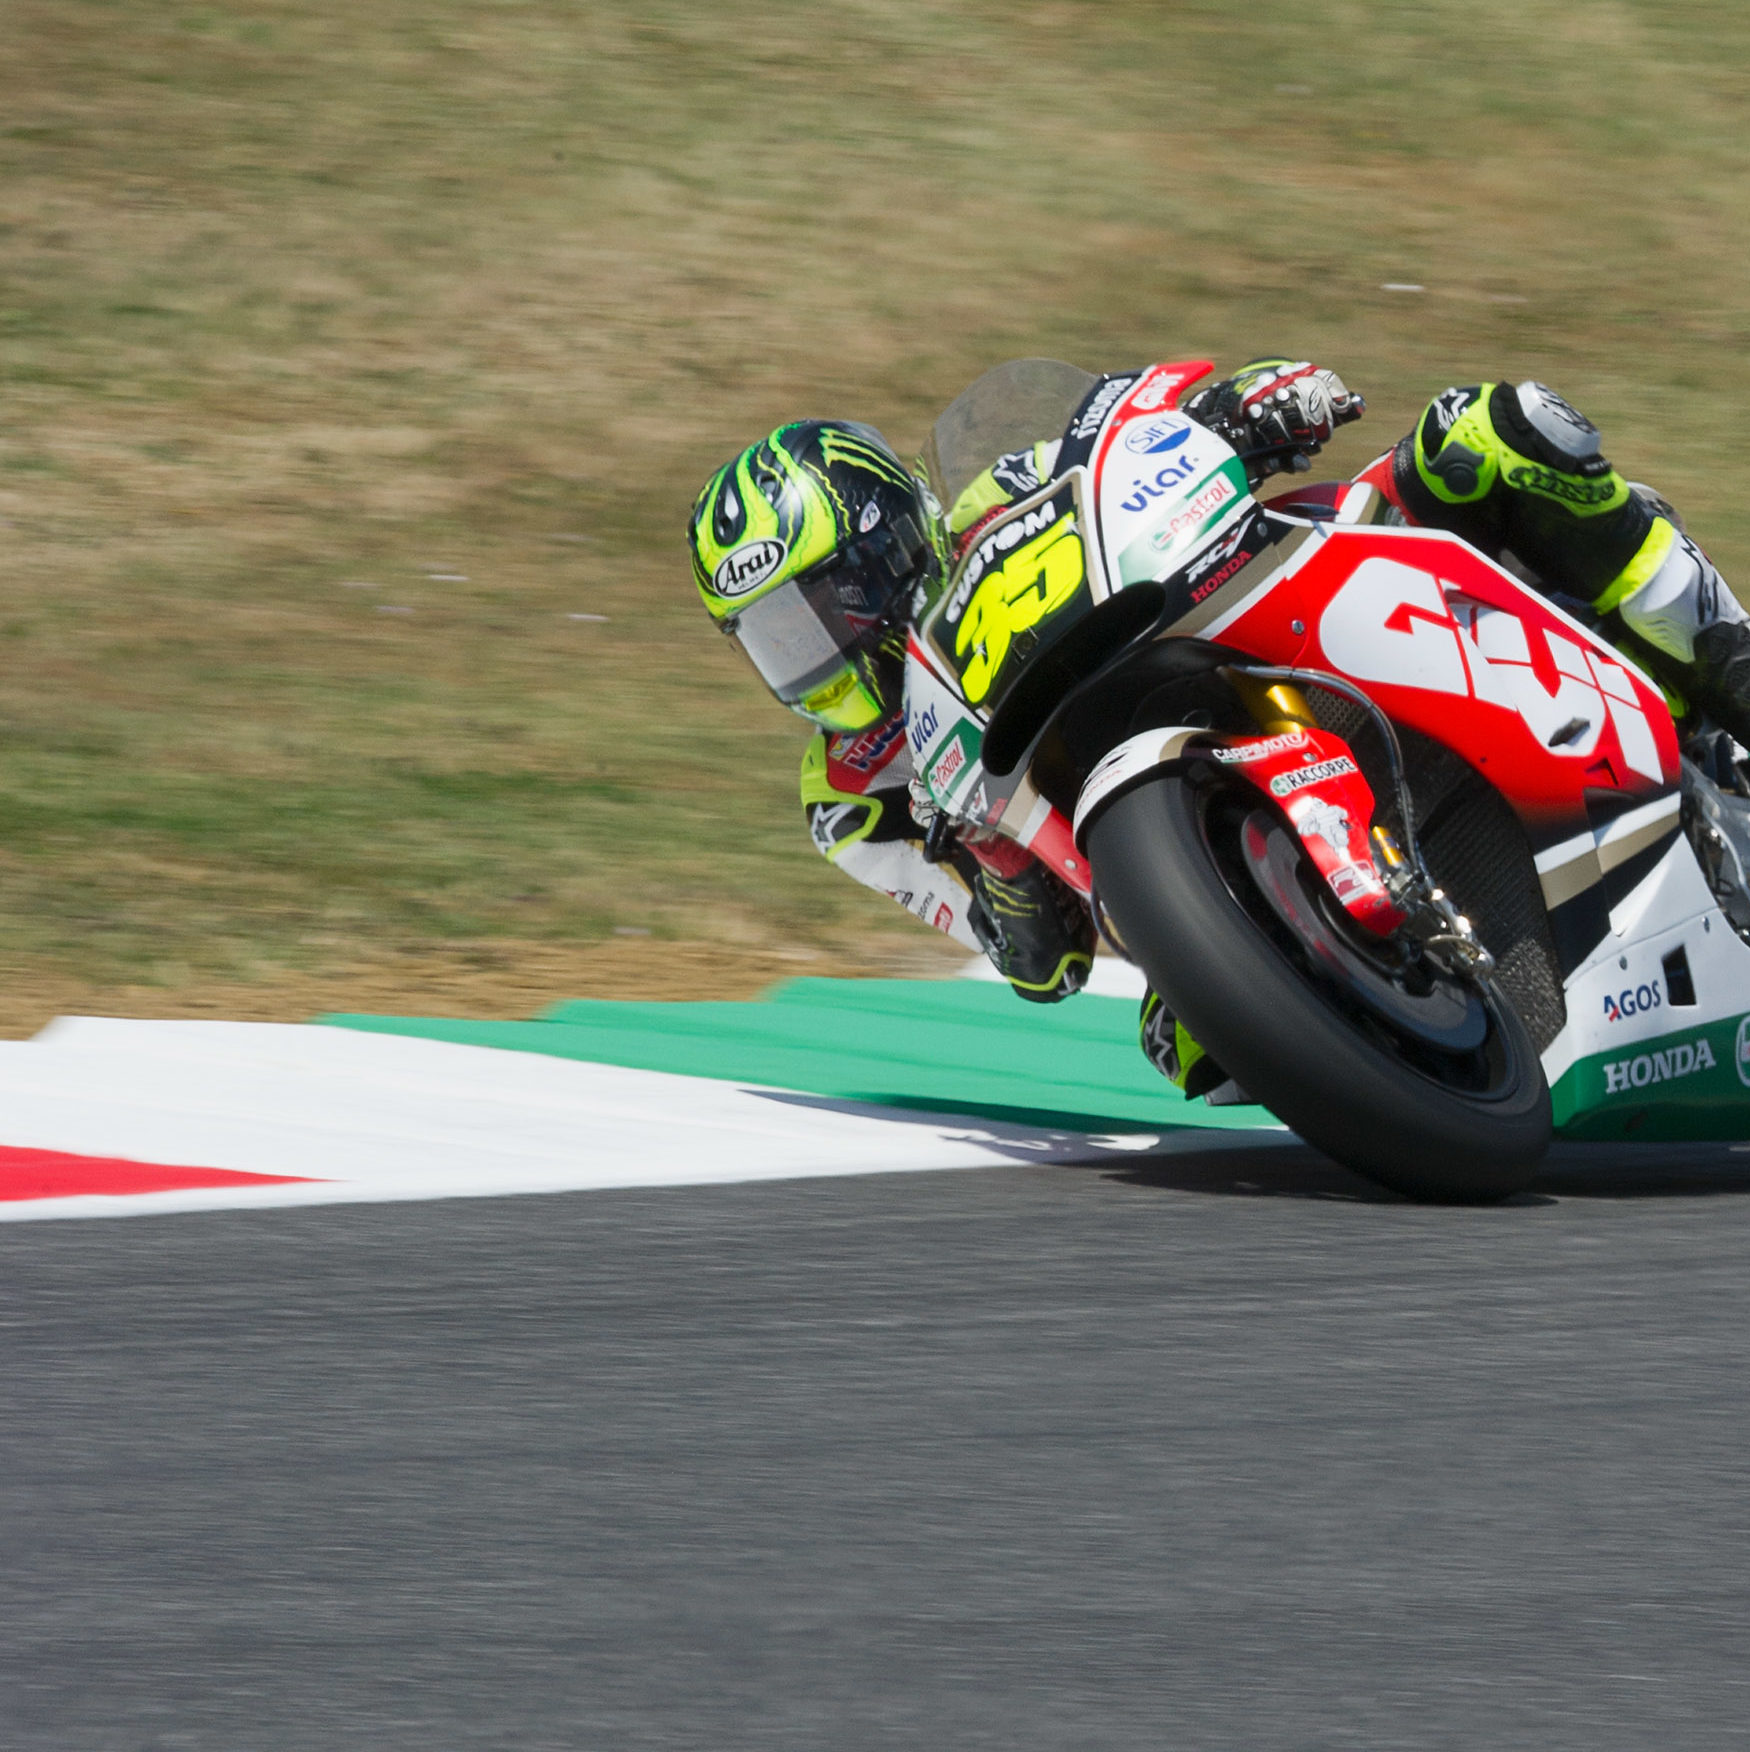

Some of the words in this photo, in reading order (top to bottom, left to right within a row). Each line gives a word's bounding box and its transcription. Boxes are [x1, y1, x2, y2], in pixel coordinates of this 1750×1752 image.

[1070, 378, 1133, 440] rizoma
[1129, 420, 1179, 450] SIFI
[1120, 454, 1196, 512] viar
[1169, 479, 1232, 534] Castrol
[719, 541, 774, 595] Arai
[945, 500, 1057, 624] CUSTOM
[1190, 550, 1253, 604] HONDA
[955, 510, 1084, 704] 35
[911, 702, 939, 753] viar
[936, 741, 964, 788] Castrol
[1288, 756, 1357, 789] RACCORPE
[1603, 979, 1662, 1022] AGOS
[1602, 1038, 1717, 1094] HONDA
